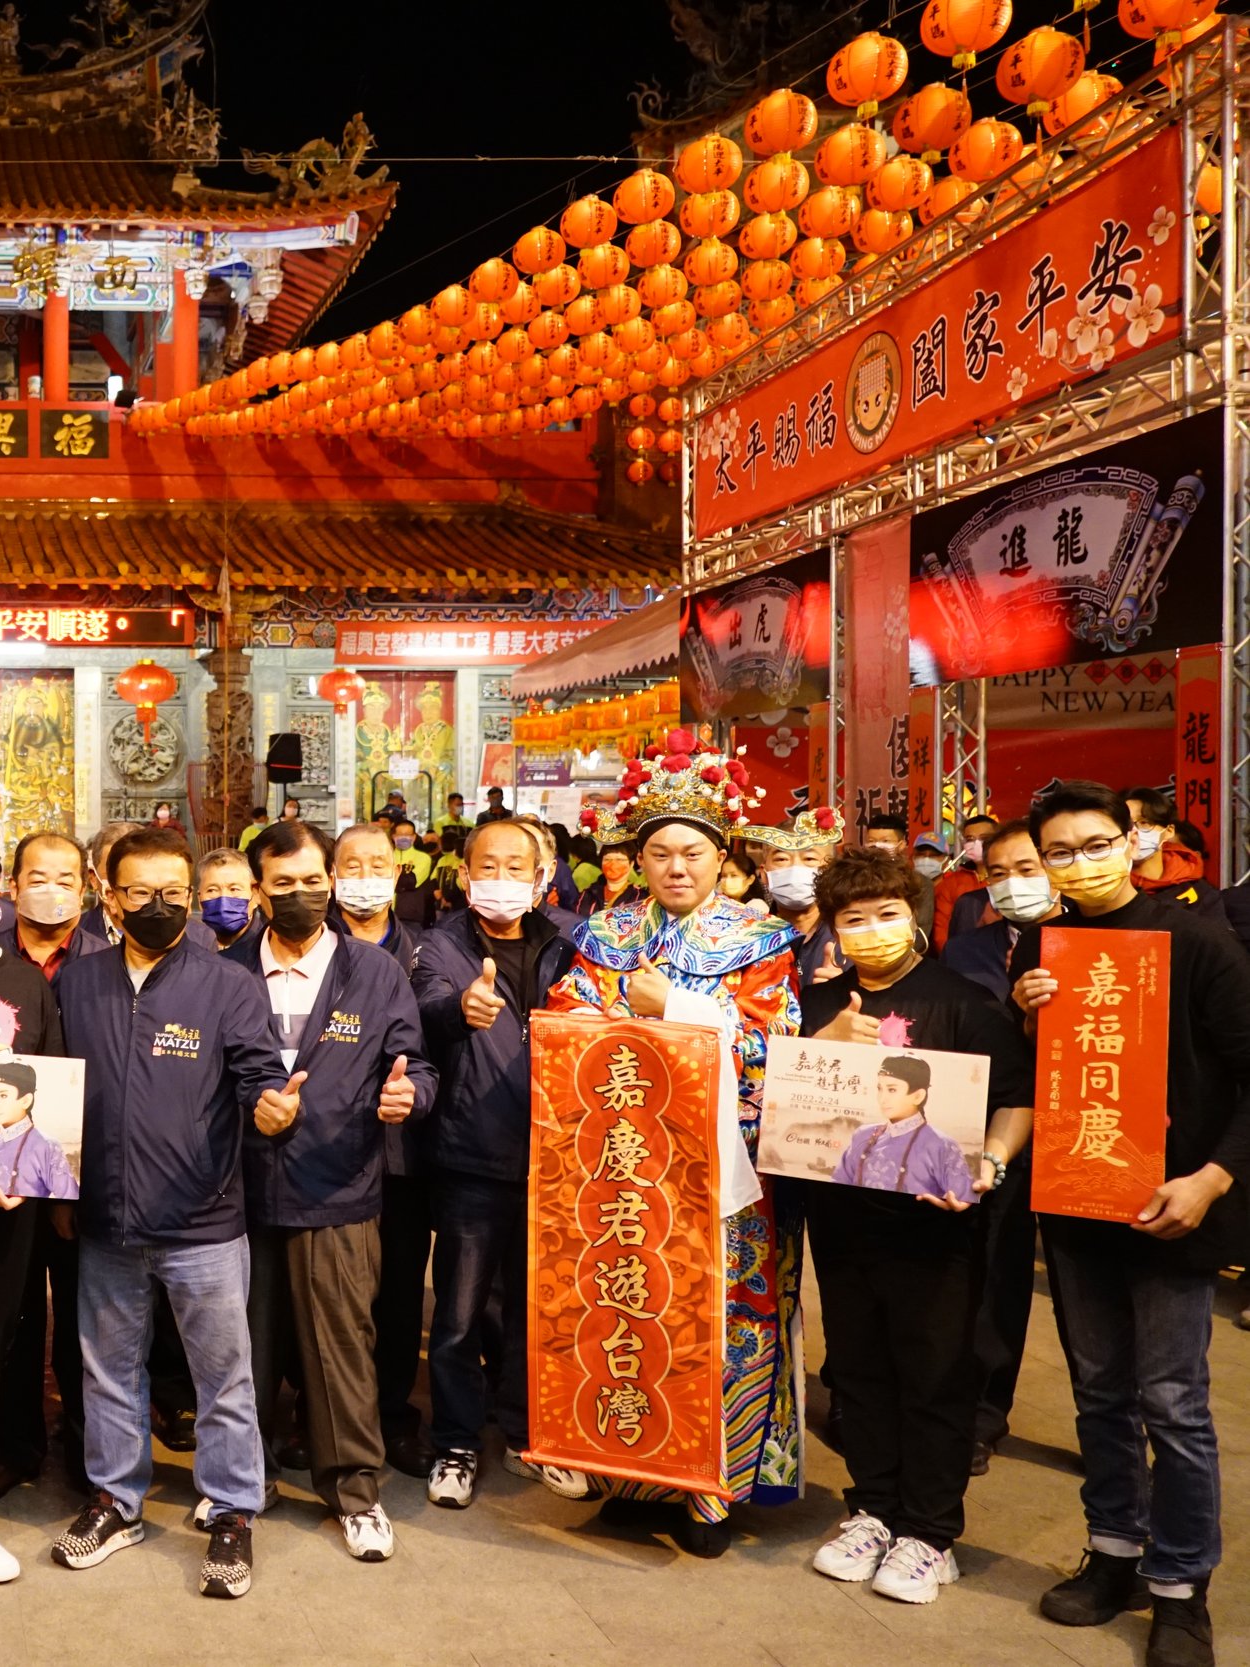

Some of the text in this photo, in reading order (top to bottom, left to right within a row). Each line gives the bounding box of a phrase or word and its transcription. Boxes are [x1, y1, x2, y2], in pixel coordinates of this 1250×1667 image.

[910, 218, 1143, 412] 闔家平安
[713, 380, 838, 500] 太平賜福
[847, 392, 899, 450] TAIPING MATZU
[1041, 691, 1175, 712] NEW YEA
[153, 1037, 200, 1050] MATZU
[325, 1024, 361, 1035] ATZU
[1068, 952, 1131, 1168] 嘉福同慶
[790, 1093, 839, 1105] 2022.2.24
[591, 1043, 658, 1448] 嘉慶君遊台灣
